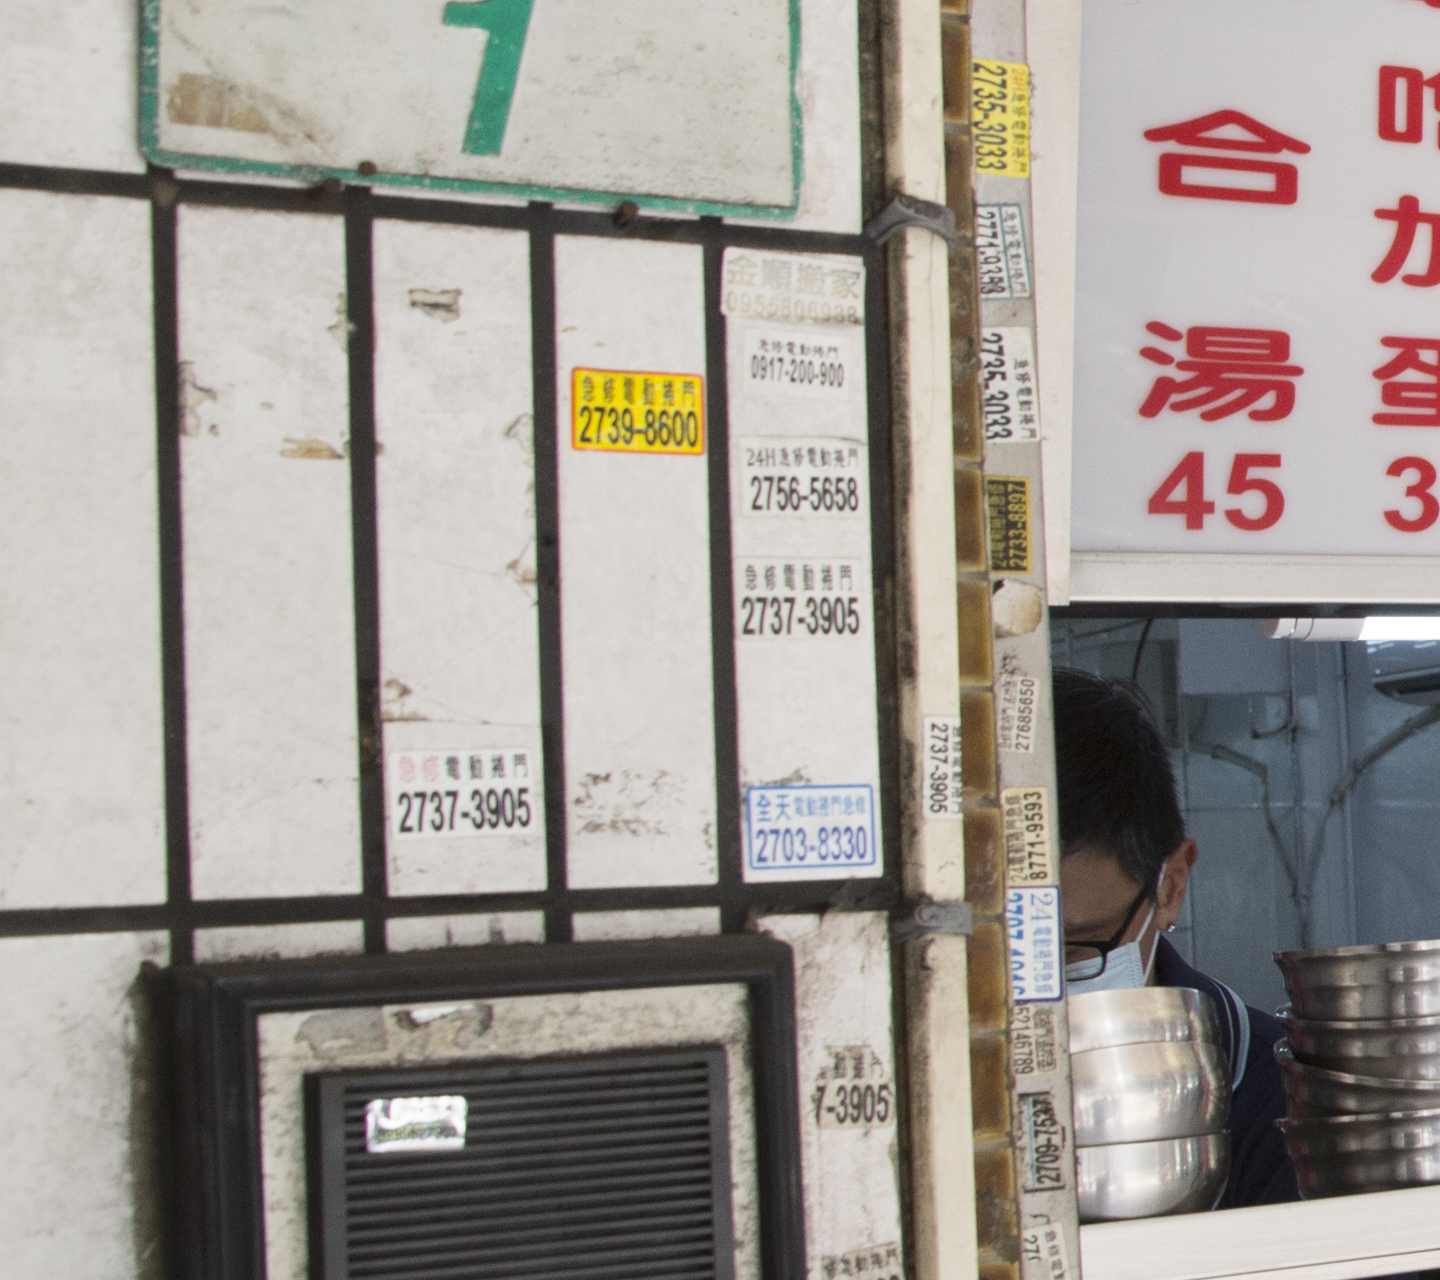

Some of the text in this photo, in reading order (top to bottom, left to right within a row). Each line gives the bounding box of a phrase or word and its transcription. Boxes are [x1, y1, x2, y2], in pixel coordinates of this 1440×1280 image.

[973, 63, 1007, 170] 2735-3033
[751, 354, 844, 387] 0917-200-900
[579, 405, 698, 448] 2739-8600
[751, 475, 859, 512] 2756-5658
[1148, 452, 1284, 531] 45
[741, 596, 860, 635] 2737-3905
[1015, 679, 1034, 751] 27685650
[930, 723, 949, 813] 2737-3905
[398, 786, 531, 833] 2737-3905
[756, 826, 867, 863] 2703-8330
